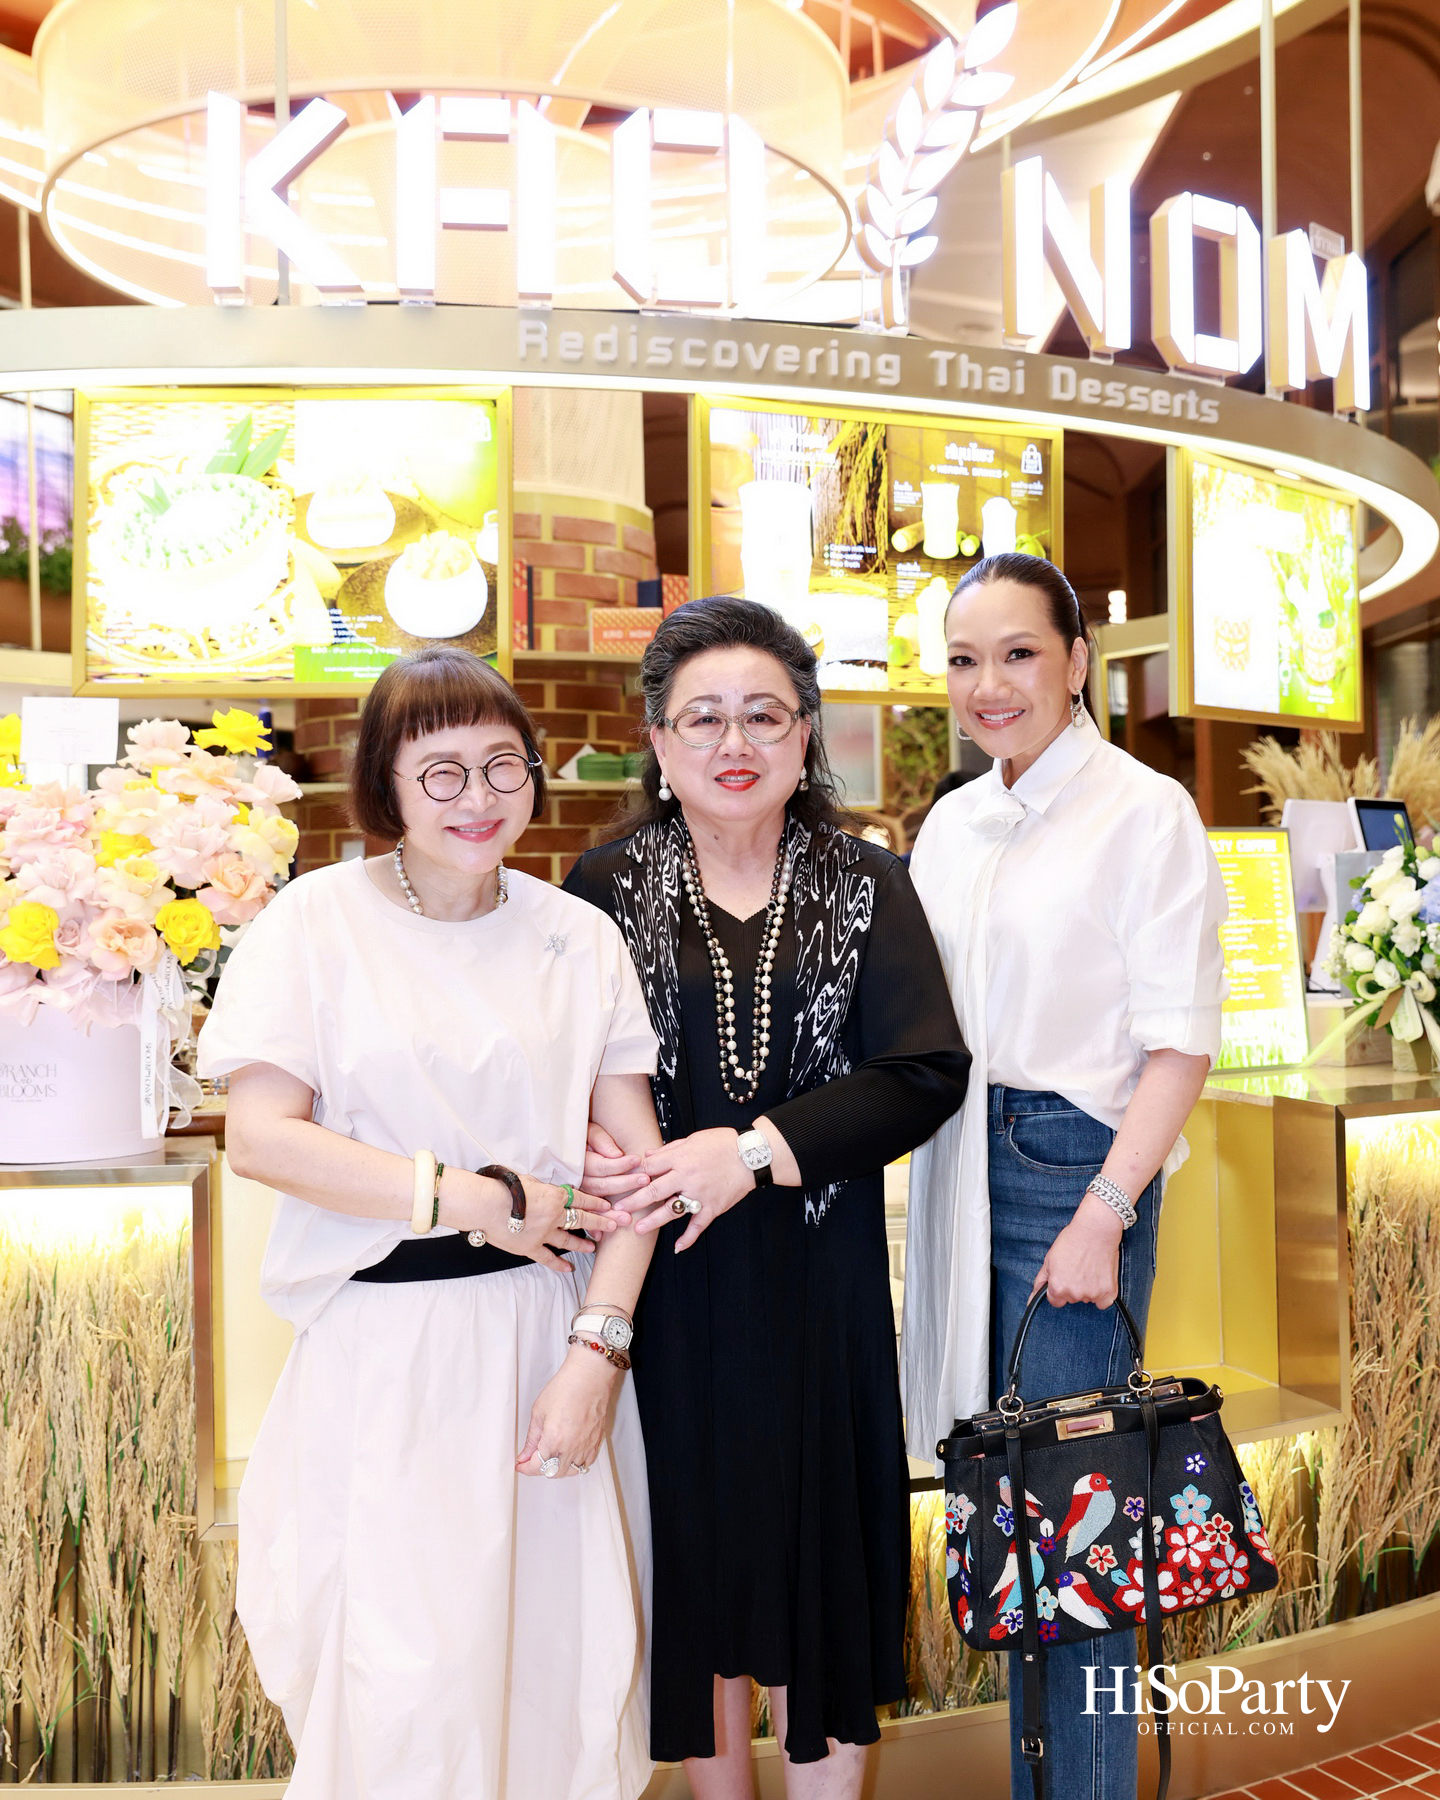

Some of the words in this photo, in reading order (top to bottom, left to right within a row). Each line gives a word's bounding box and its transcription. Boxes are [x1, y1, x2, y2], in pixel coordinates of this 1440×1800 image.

[518, 319, 902, 387] Rediscovering
[928, 350, 1026, 396] Thai
[1050, 364, 1221, 425] Desserts
[1002, 155, 1371, 412] NOM
